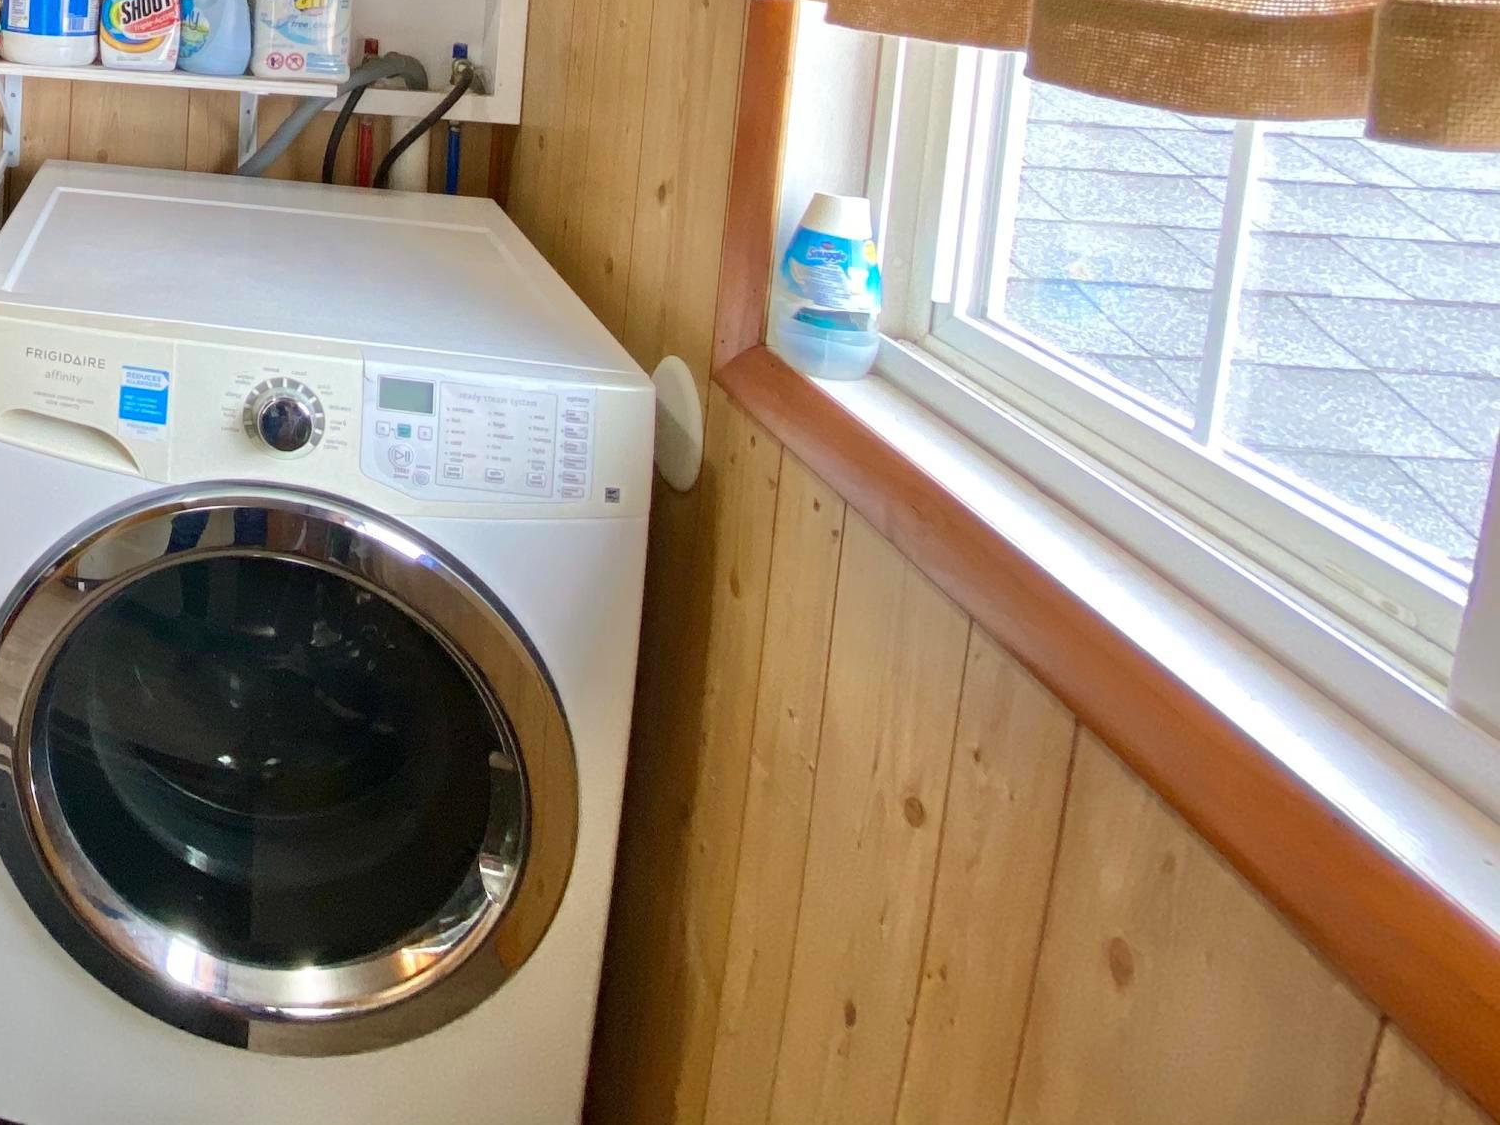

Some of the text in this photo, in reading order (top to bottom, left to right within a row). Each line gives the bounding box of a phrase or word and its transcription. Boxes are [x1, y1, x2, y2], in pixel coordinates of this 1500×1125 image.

[808, 247, 847, 263] Snuggle
[26, 347, 106, 370] FRIGIDAIRE
[45, 370, 83, 386] affinity
